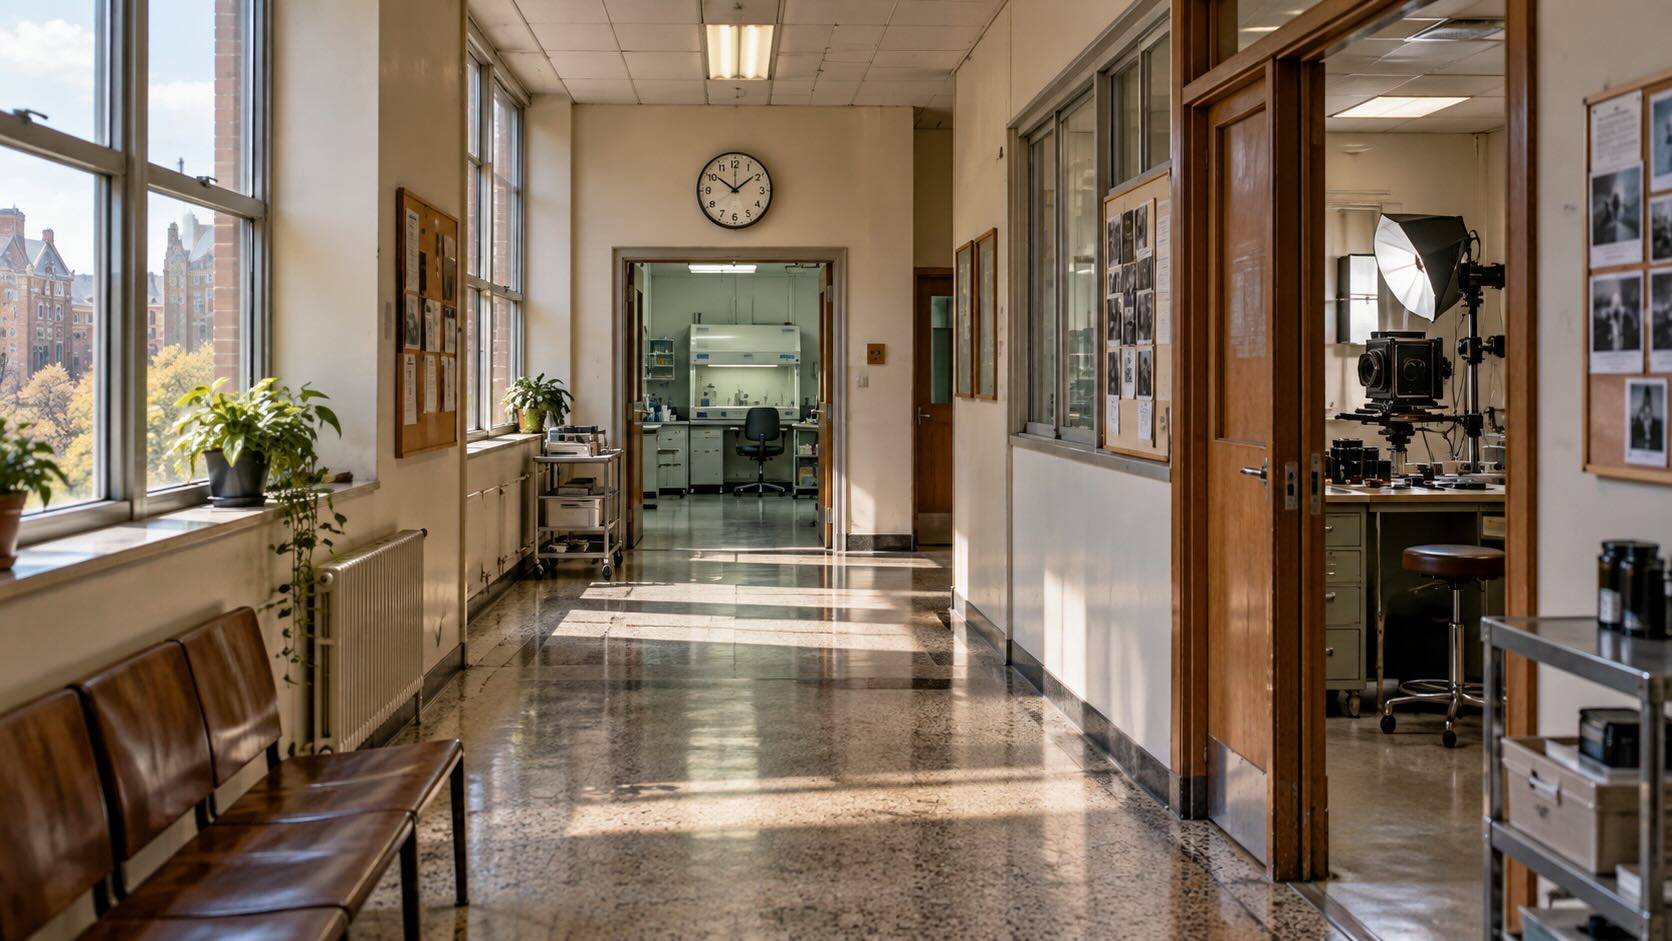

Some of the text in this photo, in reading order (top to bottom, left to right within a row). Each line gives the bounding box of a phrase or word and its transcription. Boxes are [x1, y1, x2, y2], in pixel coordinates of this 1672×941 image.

[730, 160, 739, 168] 12
[760, 186, 765, 194] 3
[732, 213, 738, 221] 6
